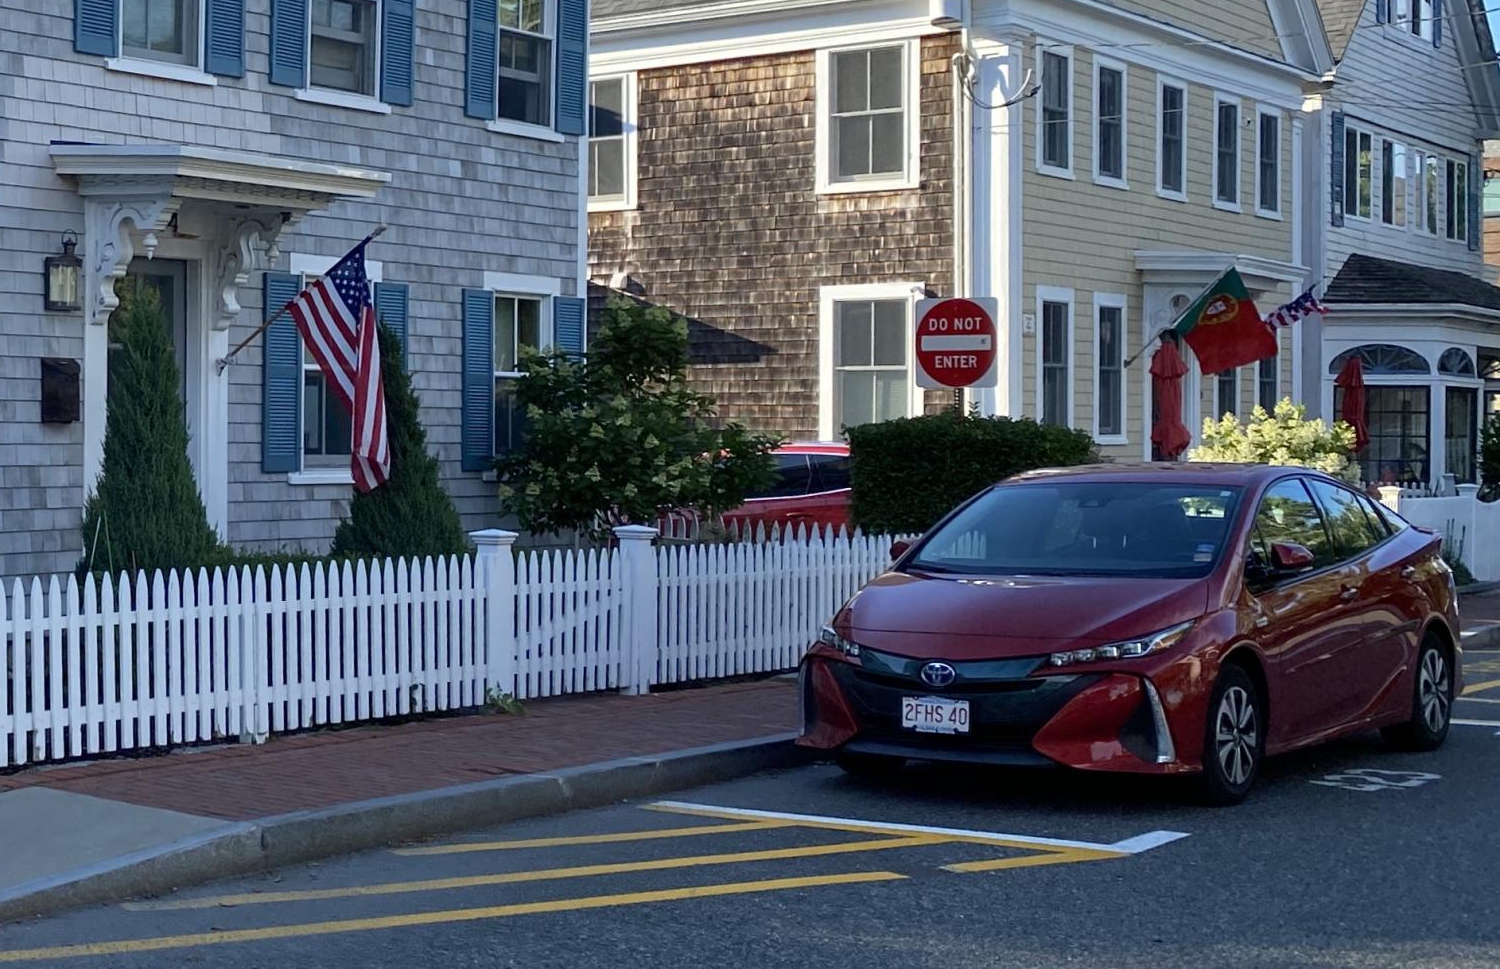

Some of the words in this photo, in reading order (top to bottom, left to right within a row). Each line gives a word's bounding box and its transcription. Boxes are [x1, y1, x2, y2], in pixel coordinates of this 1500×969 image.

[929, 318, 948, 331] DO
[954, 317, 982, 330] NOT
[935, 355, 977, 368] ENTER
[905, 703, 944, 723] 2FHS
[948, 707, 968, 725] 40
